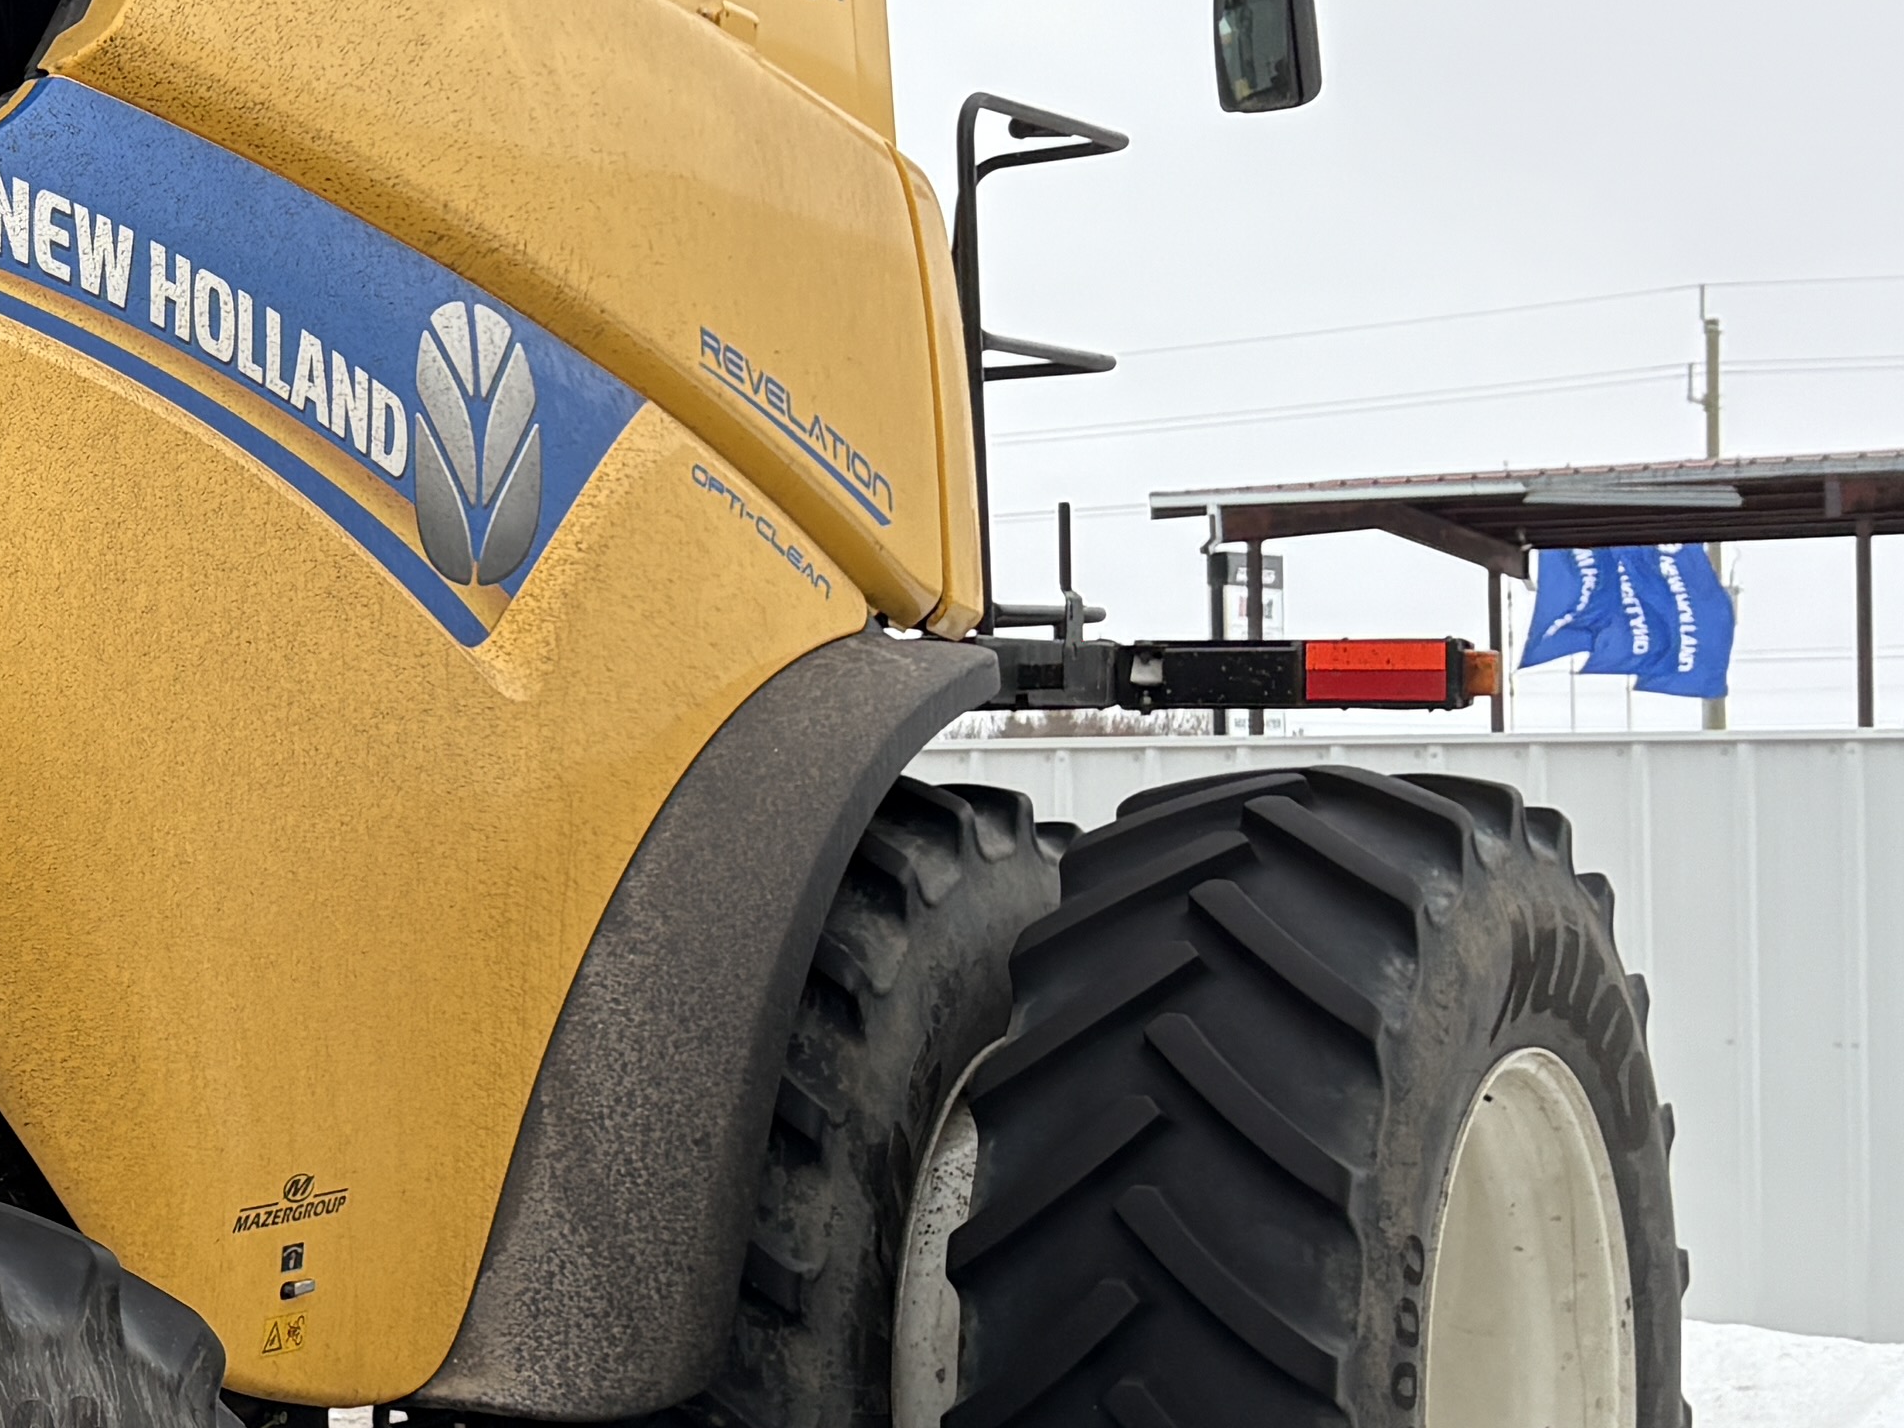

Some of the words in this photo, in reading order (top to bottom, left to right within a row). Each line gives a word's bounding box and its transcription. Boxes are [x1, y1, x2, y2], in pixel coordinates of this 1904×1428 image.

[148, 237, 410, 479] HOLLAND
[699, 325, 894, 513] REVELATION
[692, 463, 832, 601] OPTI-CLEAN
[232, 1194, 348, 1235] MAZERGROUP
